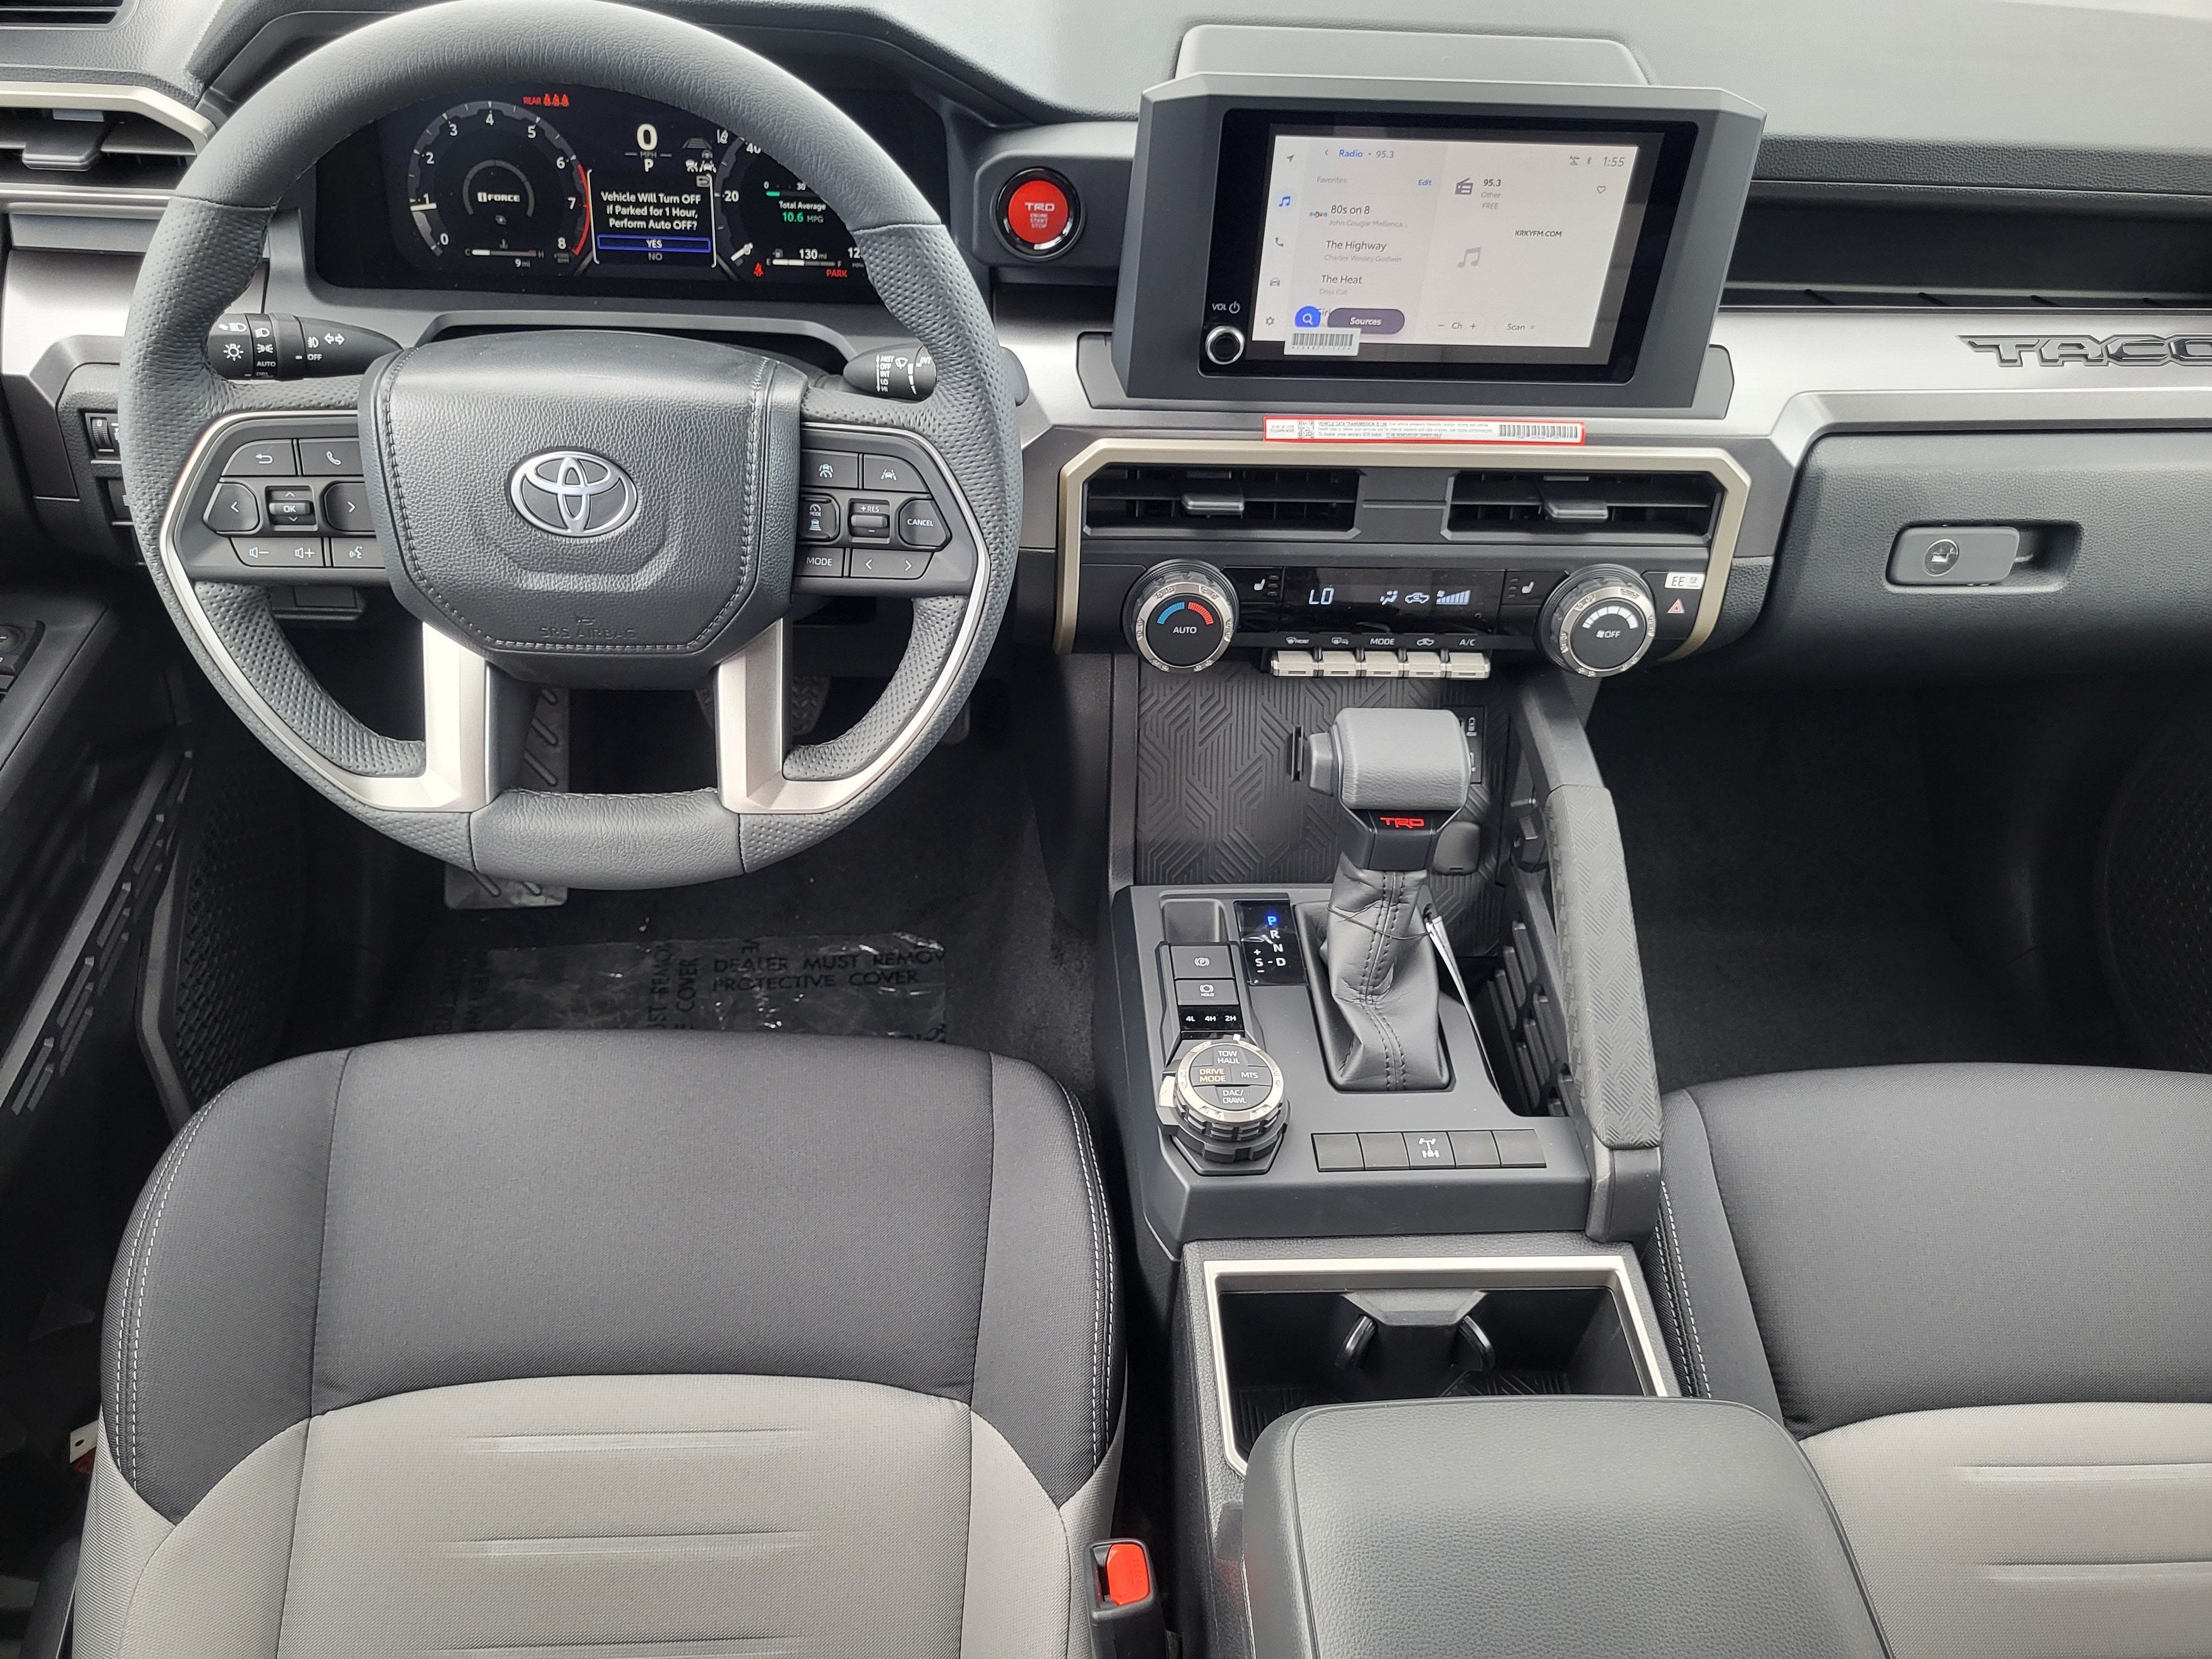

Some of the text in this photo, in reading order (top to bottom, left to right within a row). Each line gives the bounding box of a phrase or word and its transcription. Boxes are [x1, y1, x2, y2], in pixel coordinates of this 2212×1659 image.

[486, 112, 494, 126] 4
[450, 124, 458, 136] 3
[528, 127, 536, 139] 5
[637, 123, 658, 151] 0
[426, 153, 435, 164] 2
[1339, 149, 1395, 159] Radio 95.3
[557, 156, 565, 169] 6
[644, 158, 654, 173] P
[1603, 156, 1625, 167] 1:55
[764, 181, 769, 189] 0
[797, 182, 806, 191] 30
[1483, 179, 1501, 187] 95.3
[424, 194, 430, 205] 1
[601, 191, 701, 205] Vehicle Will Turn OFF
[724, 190, 739, 202] 20
[568, 197, 576, 210] 7
[779, 200, 826, 212] Total Average
[1025, 202, 1056, 212] TRD
[614, 205, 648, 216] Parked
[649, 206, 663, 216] for
[665, 207, 670, 216] 1
[671, 207, 698, 219] Hour,
[1331, 205, 1348, 215] 80s
[1364, 206, 1370, 215] 8
[782, 211, 824, 223] 10.6 MPG
[609, 217, 698, 231] Perform Auto OFF?
[440, 234, 449, 246] 0
[557, 237, 566, 249] 8
[646, 239, 663, 249] YES
[1326, 240, 1387, 253] The Highway
[648, 252, 663, 261] NO
[799, 248, 818, 259] 130
[515, 258, 521, 267] 9
[826, 269, 848, 278] PARK
[1321, 275, 1363, 285] The Heat
[1349, 316, 1383, 326] Sources
[1452, 322, 1463, 330] Ch
[907, 518, 933, 526] CANCEL
[806, 557, 833, 566] MODE
[1671, 576, 1686, 586] EE
[1172, 626, 1197, 634] AUTO
[1604, 630, 1621, 639] OFF
[1459, 638, 1476, 646] A/C
[1380, 816, 1425, 829] TRD
[1267, 916, 1277, 925] P
[1270, 930, 1280, 939] R
[1273, 944, 1284, 952] N
[713, 957, 788, 973] DEALER
[803, 954, 858, 970] MUST
[1255, 958, 1264, 967] S
[1276, 958, 1286, 967] D
[713, 971, 919, 991] PROTECTIVE COVER
